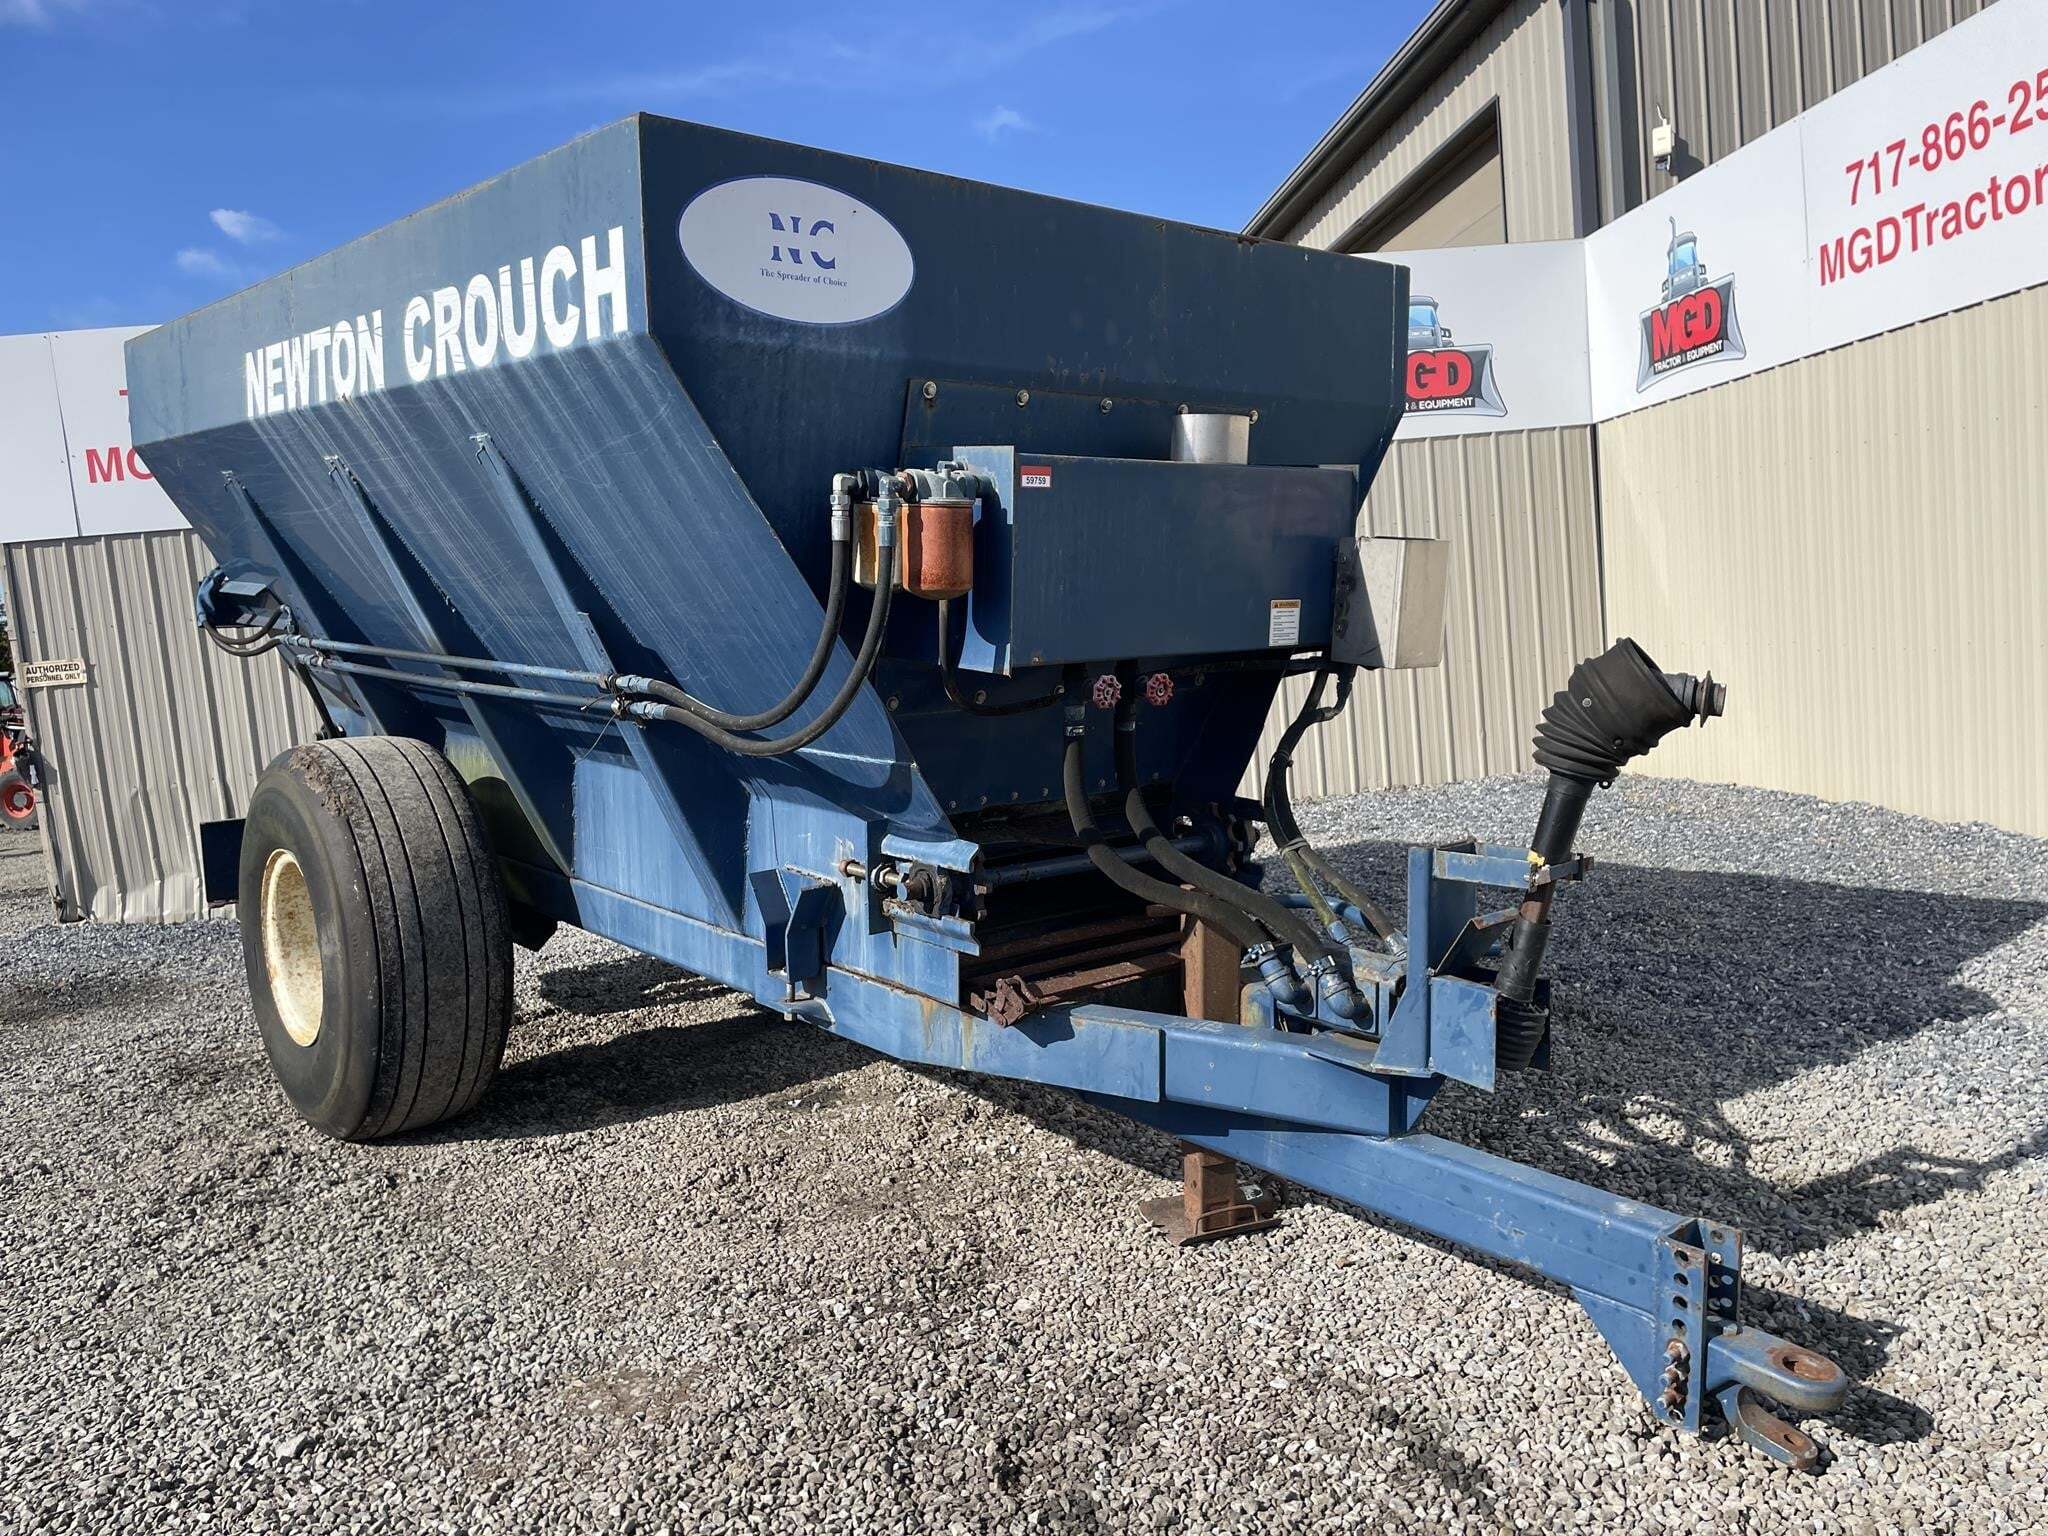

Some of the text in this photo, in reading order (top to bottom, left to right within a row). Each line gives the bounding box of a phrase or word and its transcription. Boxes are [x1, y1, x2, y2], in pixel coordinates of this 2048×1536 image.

[1819, 163, 2048, 286] MGDTractor
[768, 212, 836, 270] NC
[760, 268, 848, 287] The Spreader of Choice
[245, 225, 629, 418] NEWTON CROUCH
[1650, 287, 1722, 364] MGD
[1653, 355, 1682, 373] TRACTOR
[1686, 340, 1723, 362] EQUIPMENT
[1419, 397, 1474, 410] EQUIPMENT
[1026, 476, 1046, 485] 59759
[26, 663, 80, 675] AUTHORIZED
[26, 672, 80, 683] PERSONNEL ONLY
